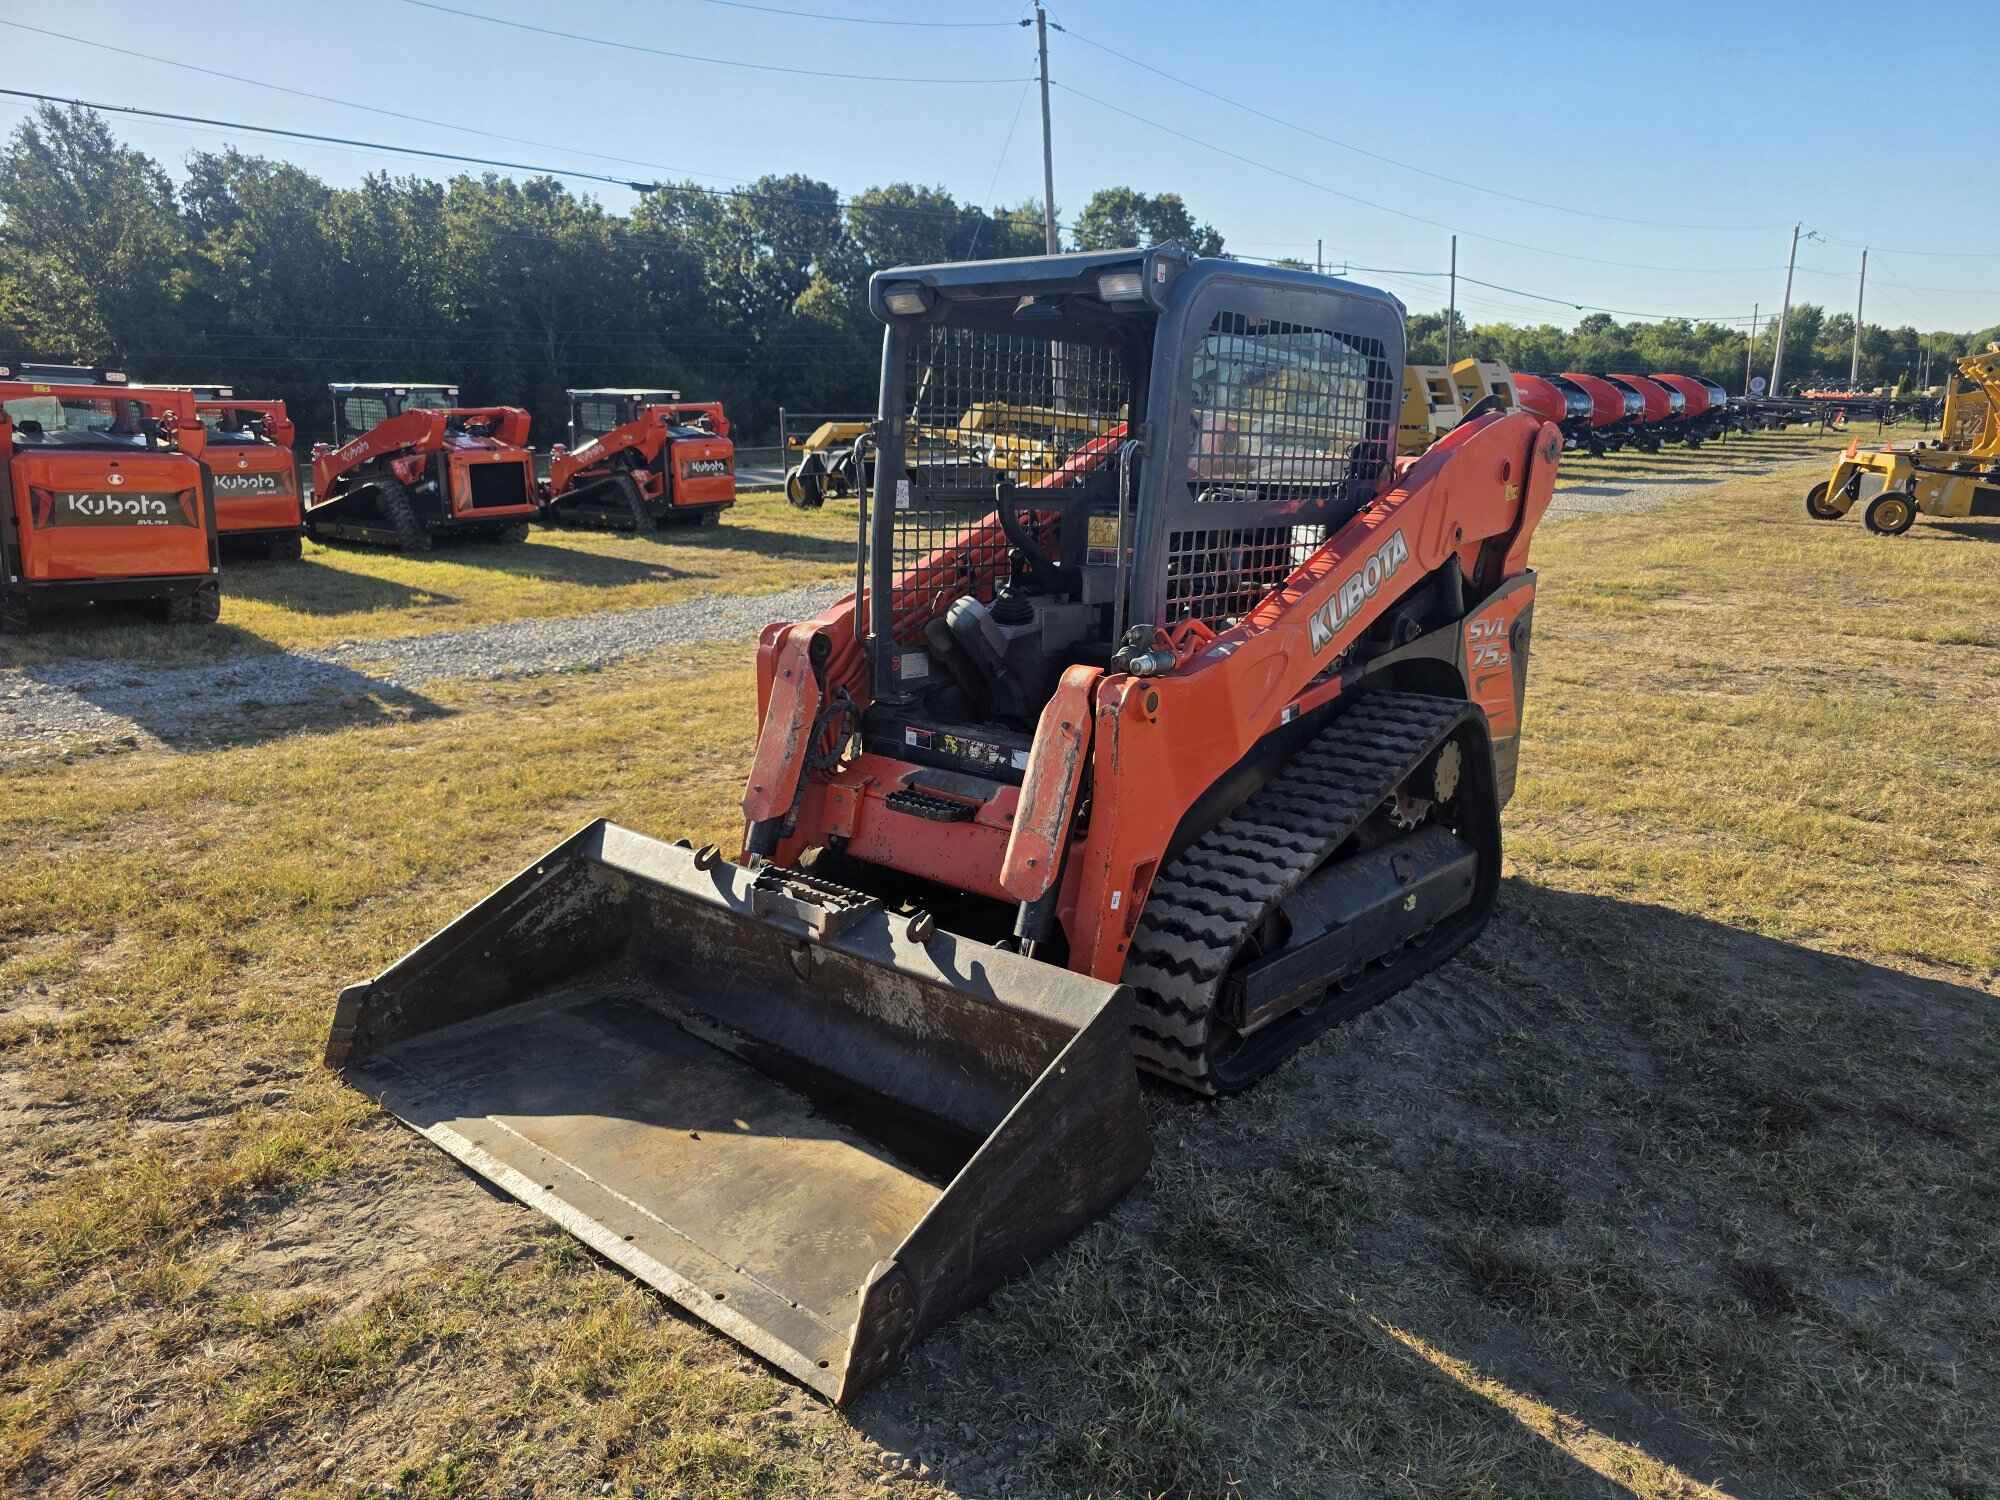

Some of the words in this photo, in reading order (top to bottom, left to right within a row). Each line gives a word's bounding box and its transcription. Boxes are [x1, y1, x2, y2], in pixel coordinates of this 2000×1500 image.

[692, 460, 724, 473] Kubota
[214, 473, 275, 489] Kubota
[68, 494, 167, 515] Kubota
[1309, 528, 1408, 656] KUBOTA
[1470, 618, 1509, 640] SVL
